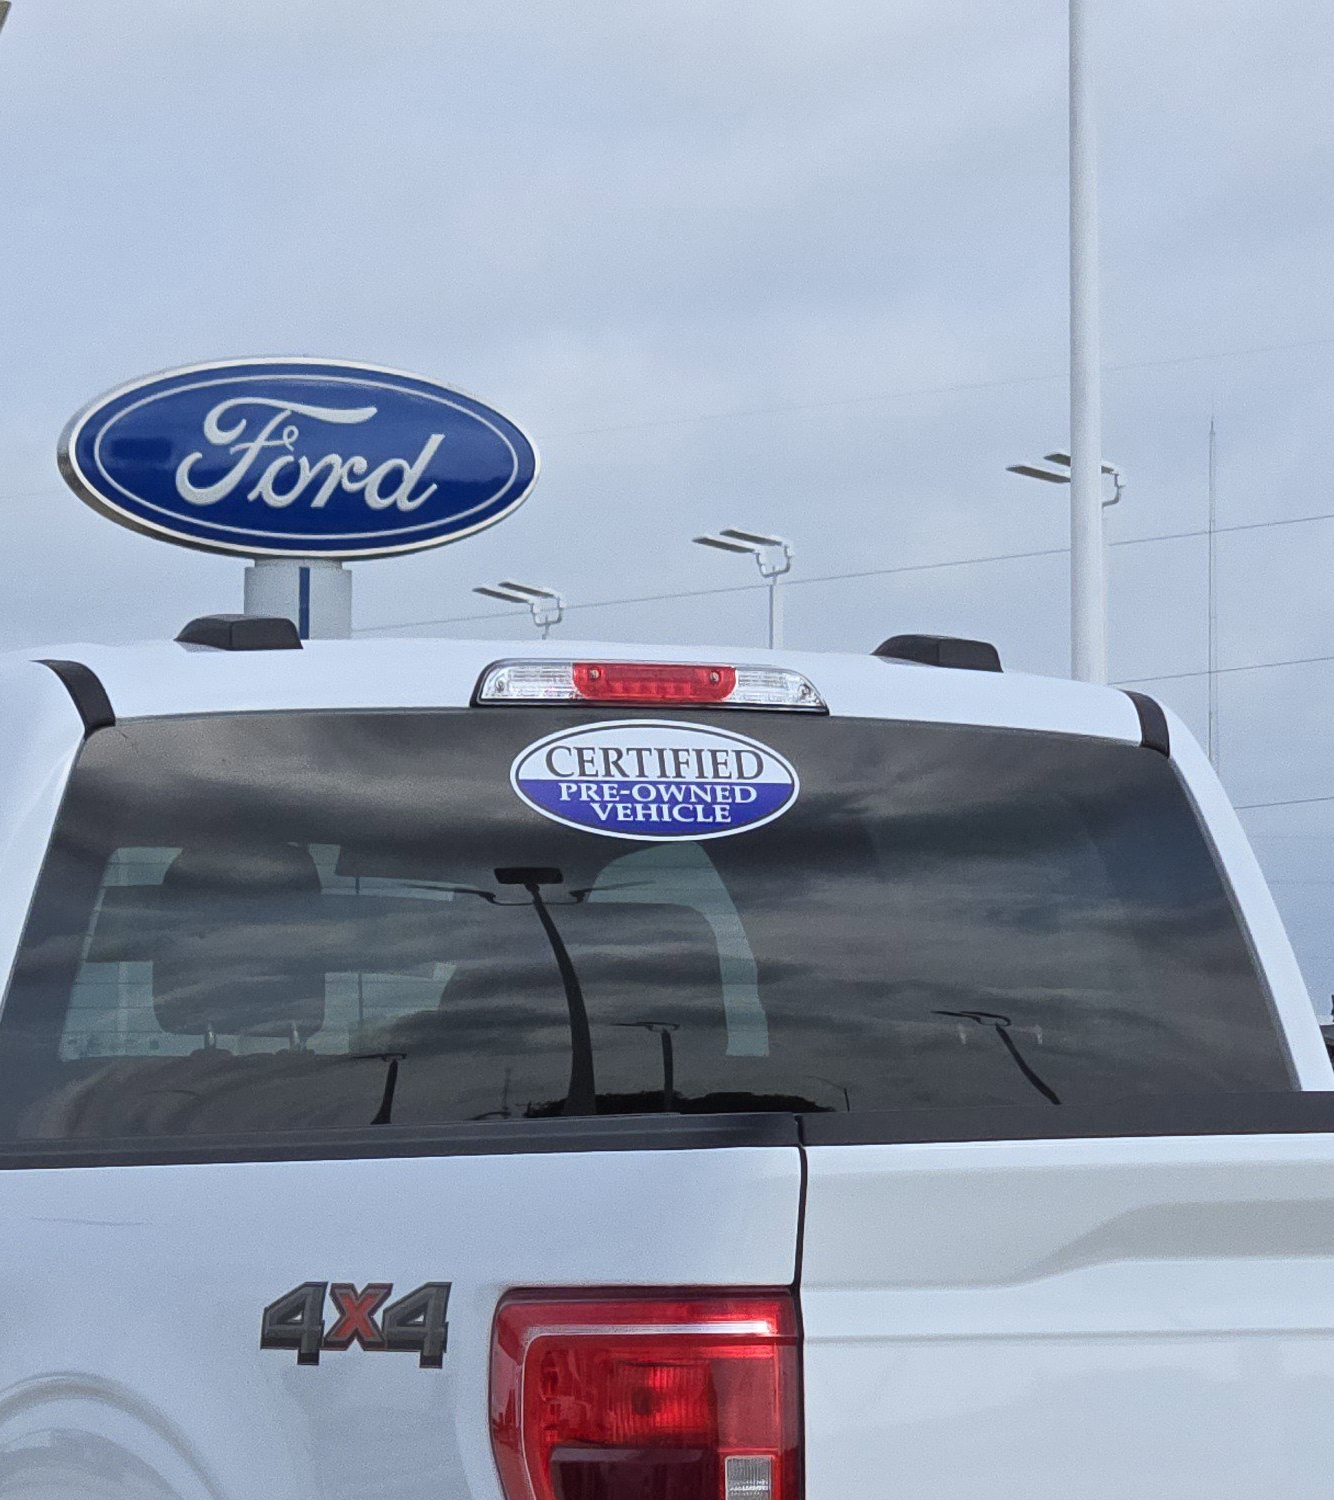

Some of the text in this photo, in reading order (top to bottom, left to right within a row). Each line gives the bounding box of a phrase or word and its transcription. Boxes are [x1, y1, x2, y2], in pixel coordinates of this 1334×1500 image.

[175, 396, 445, 512] Ford
[545, 744, 765, 781] CERTIFIED
[558, 782, 758, 804] PRE-OWNED
[589, 802, 732, 823] VEHICLE
